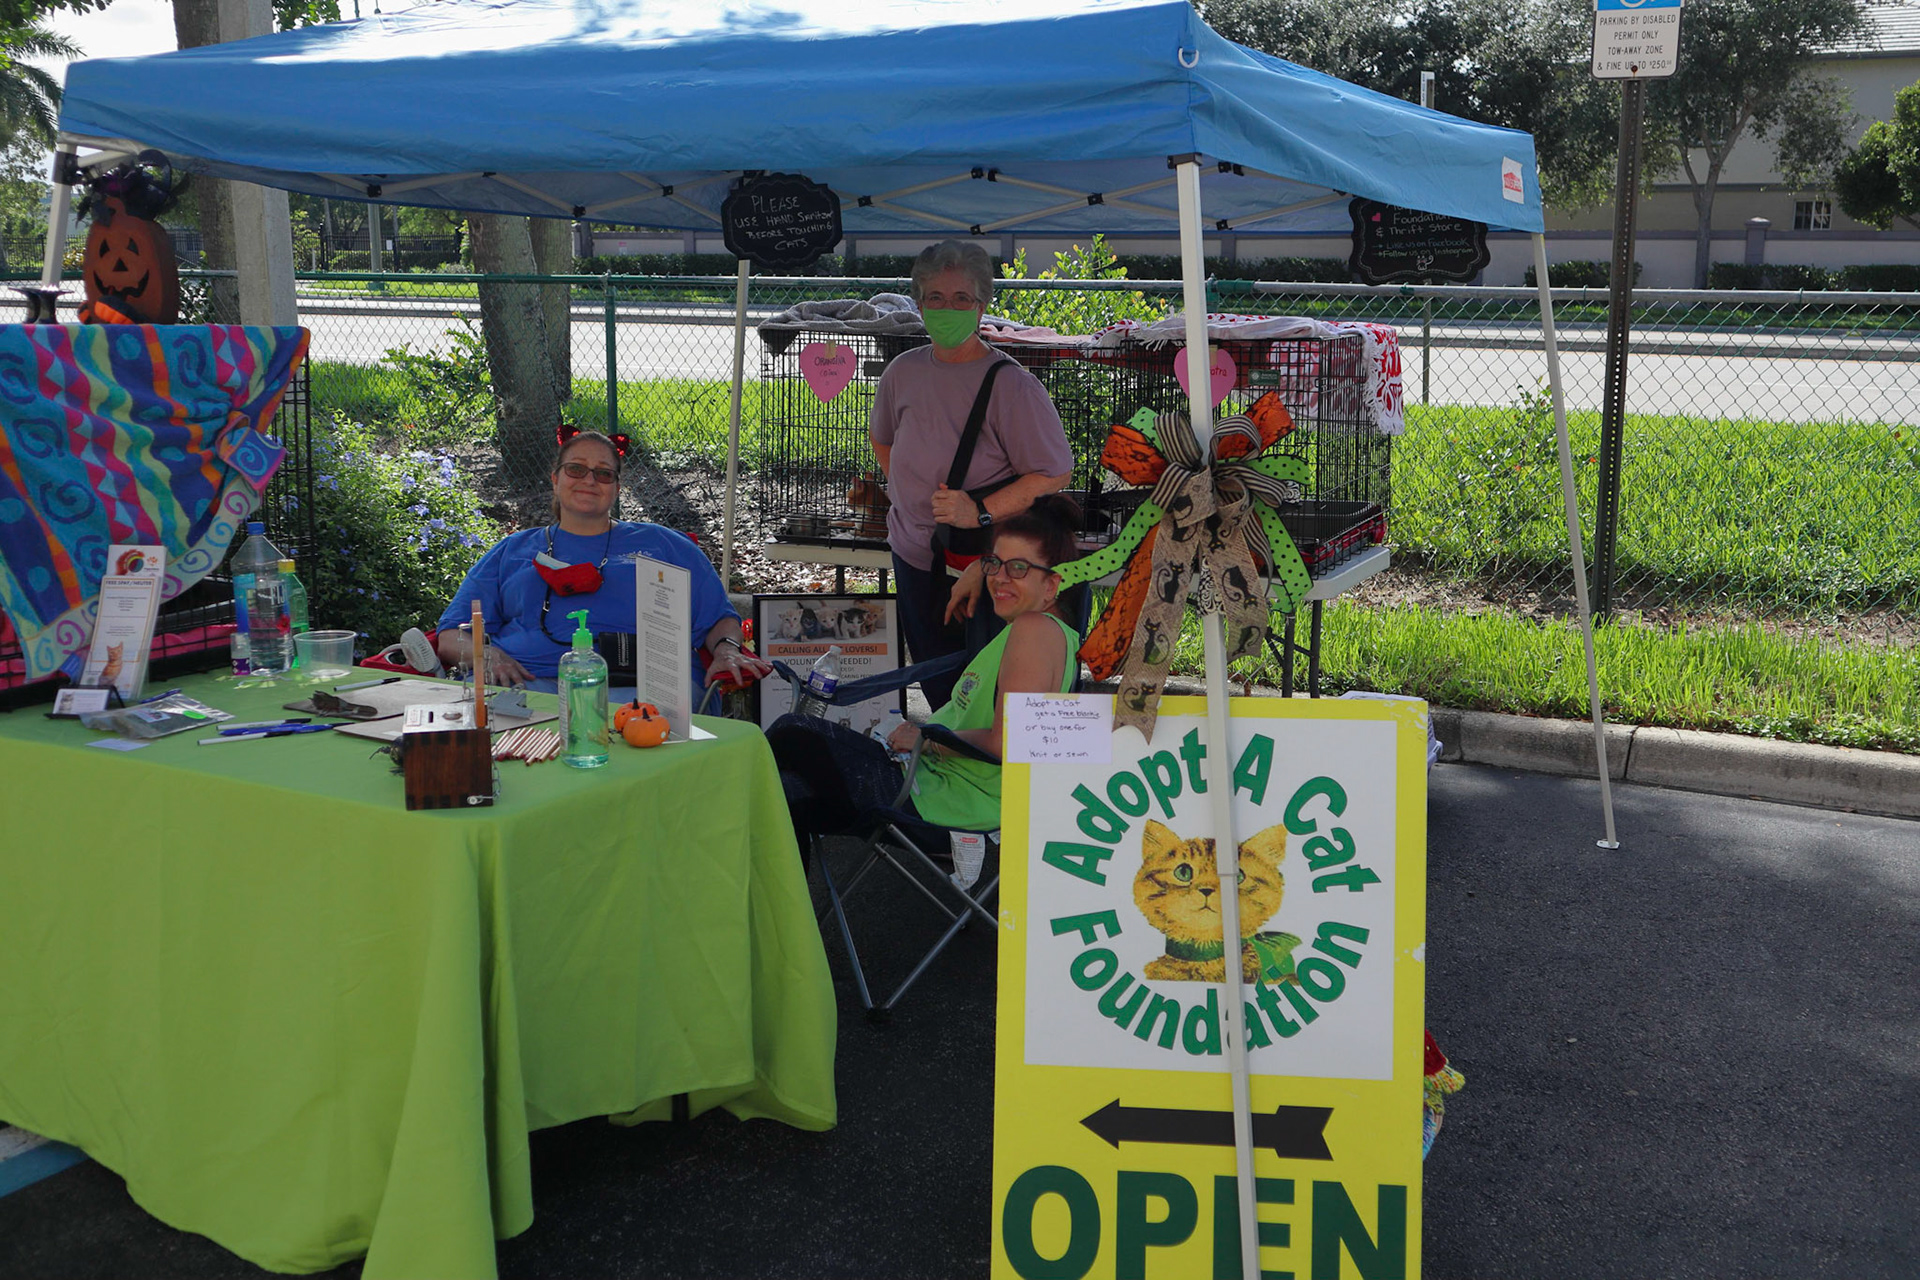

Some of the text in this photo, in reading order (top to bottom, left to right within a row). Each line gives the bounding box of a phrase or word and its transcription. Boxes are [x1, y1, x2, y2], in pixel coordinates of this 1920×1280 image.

[1600, 14, 1676, 26] PARKING BY DISABLED
[1613, 30, 1659, 40] PERMIT ONLY
[1608, 45, 1664, 56] TOW-AWAY ZONE
[1606, 61, 1622, 71] FINE
[1638, 60, 1647, 70] TO
[751, 195, 800, 213] PLEASE
[734, 216, 759, 228] USE
[765, 213, 794, 226] HAND
[746, 229, 784, 240] BEFORE
[1389, 224, 1424, 236] Thrift
[774, 238, 808, 250] CATS
[1382, 248, 1407, 258] Follow
[778, 646, 811, 654] CALLING
[845, 645, 878, 654] LOVERS!
[1025, 697, 1050, 708] Adopt
[1062, 699, 1081, 707] Cat
[1035, 711, 1049, 720] get
[1025, 724, 1038, 732] or
[1040, 724, 1057, 734] buy
[1073, 723, 1087, 731] for
[1042, 736, 1059, 745] $10
[1042, 727, 1382, 894] Adopt A Cat
[1050, 909, 1370, 1056] Foundation
[1002, 1164, 1408, 1280] OPEN
